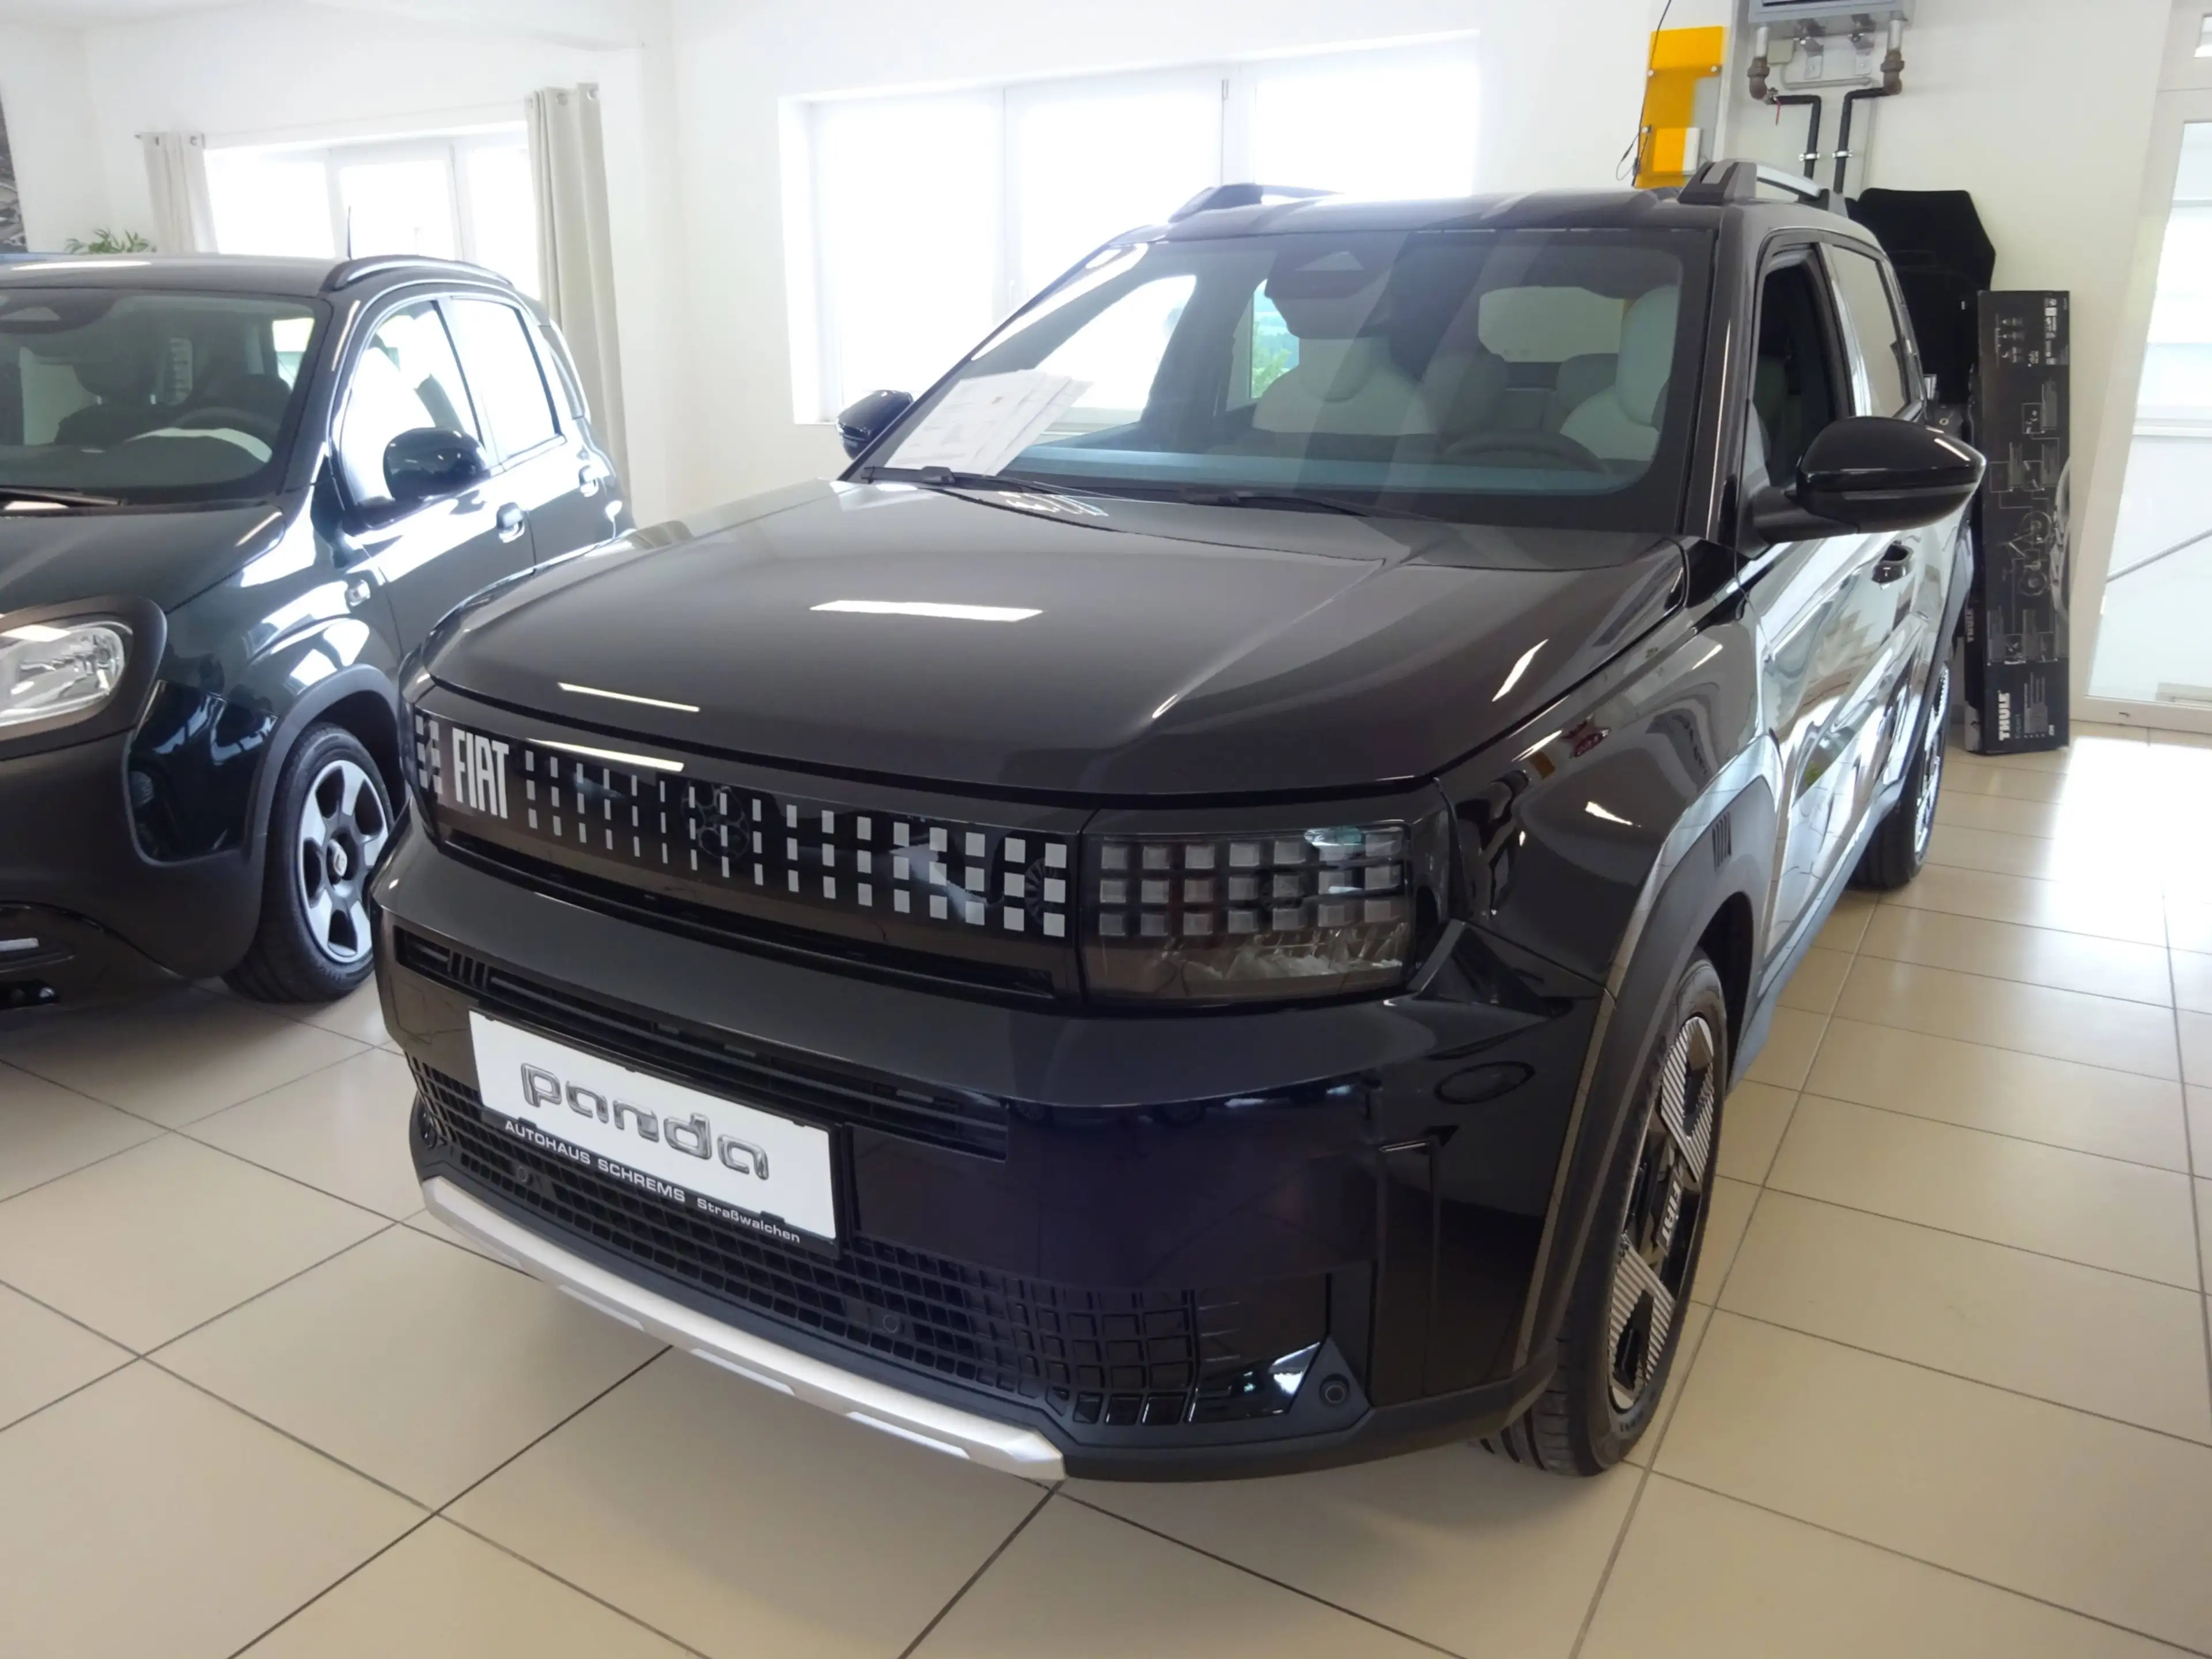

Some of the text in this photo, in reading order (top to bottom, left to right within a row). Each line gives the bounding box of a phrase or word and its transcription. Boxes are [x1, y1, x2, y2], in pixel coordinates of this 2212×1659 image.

[1998, 692, 2011, 741] THULE
[452, 727, 510, 819] FIAT
[520, 1062, 770, 1180] panda
[505, 1119, 801, 1244] AUTOHAUS SCHREMS Straßwalchen
[1661, 1180, 1681, 1248] FIAT
